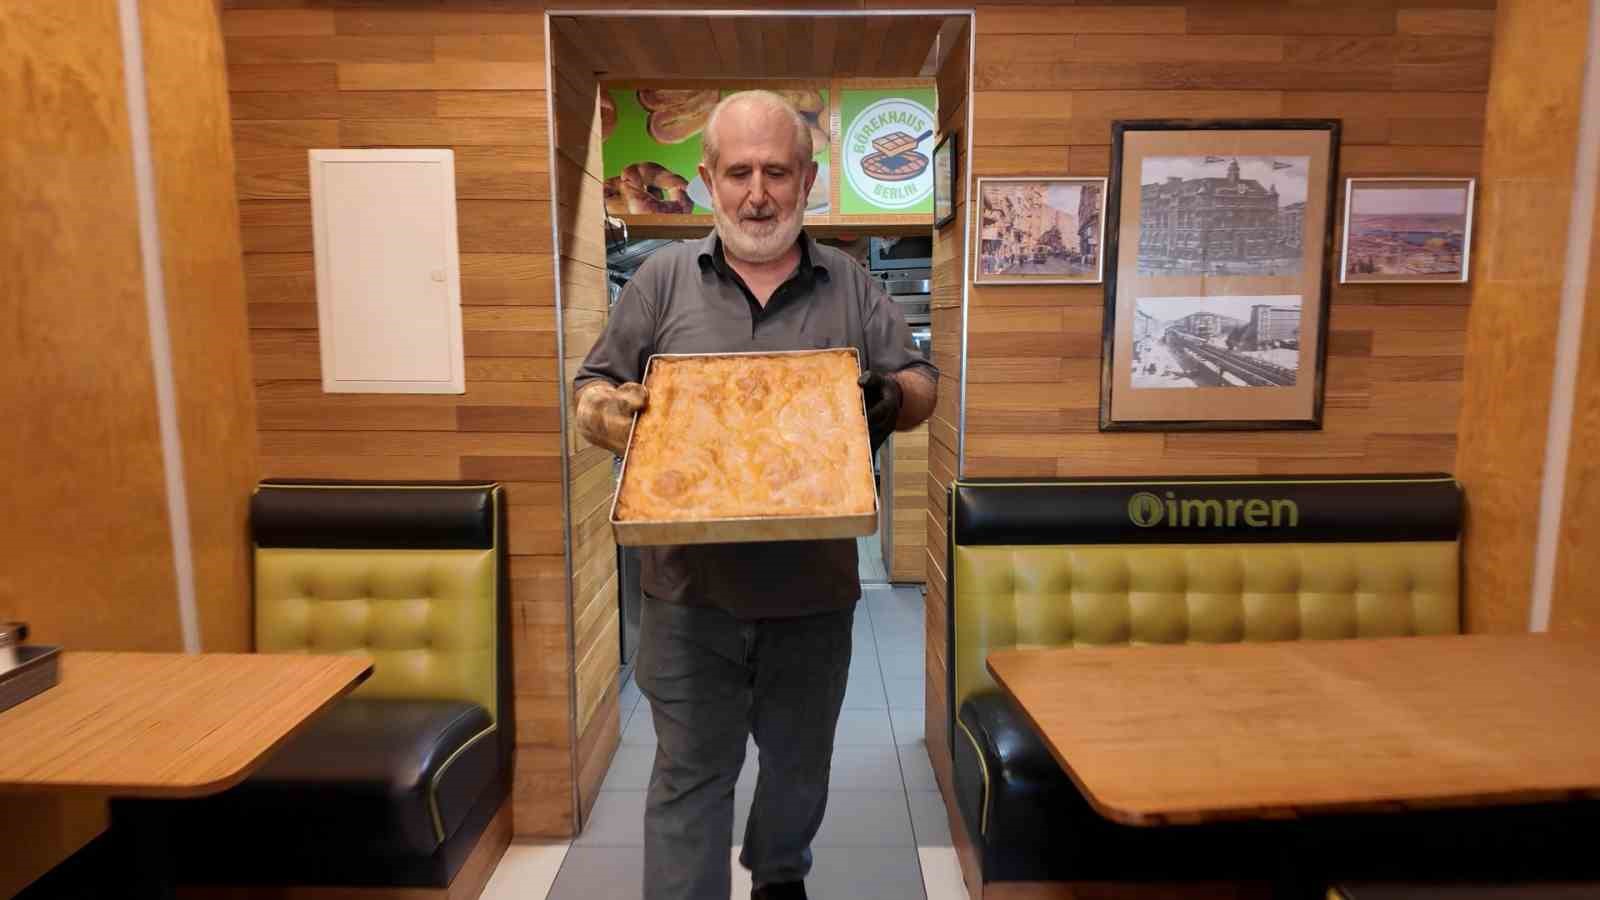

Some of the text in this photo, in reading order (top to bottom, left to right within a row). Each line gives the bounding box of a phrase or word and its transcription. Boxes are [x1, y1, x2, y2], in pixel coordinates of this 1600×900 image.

[853, 110, 926, 154] BÖREKHAUS
[873, 183, 919, 200] BERLIN
[1165, 491, 1298, 528] imren
